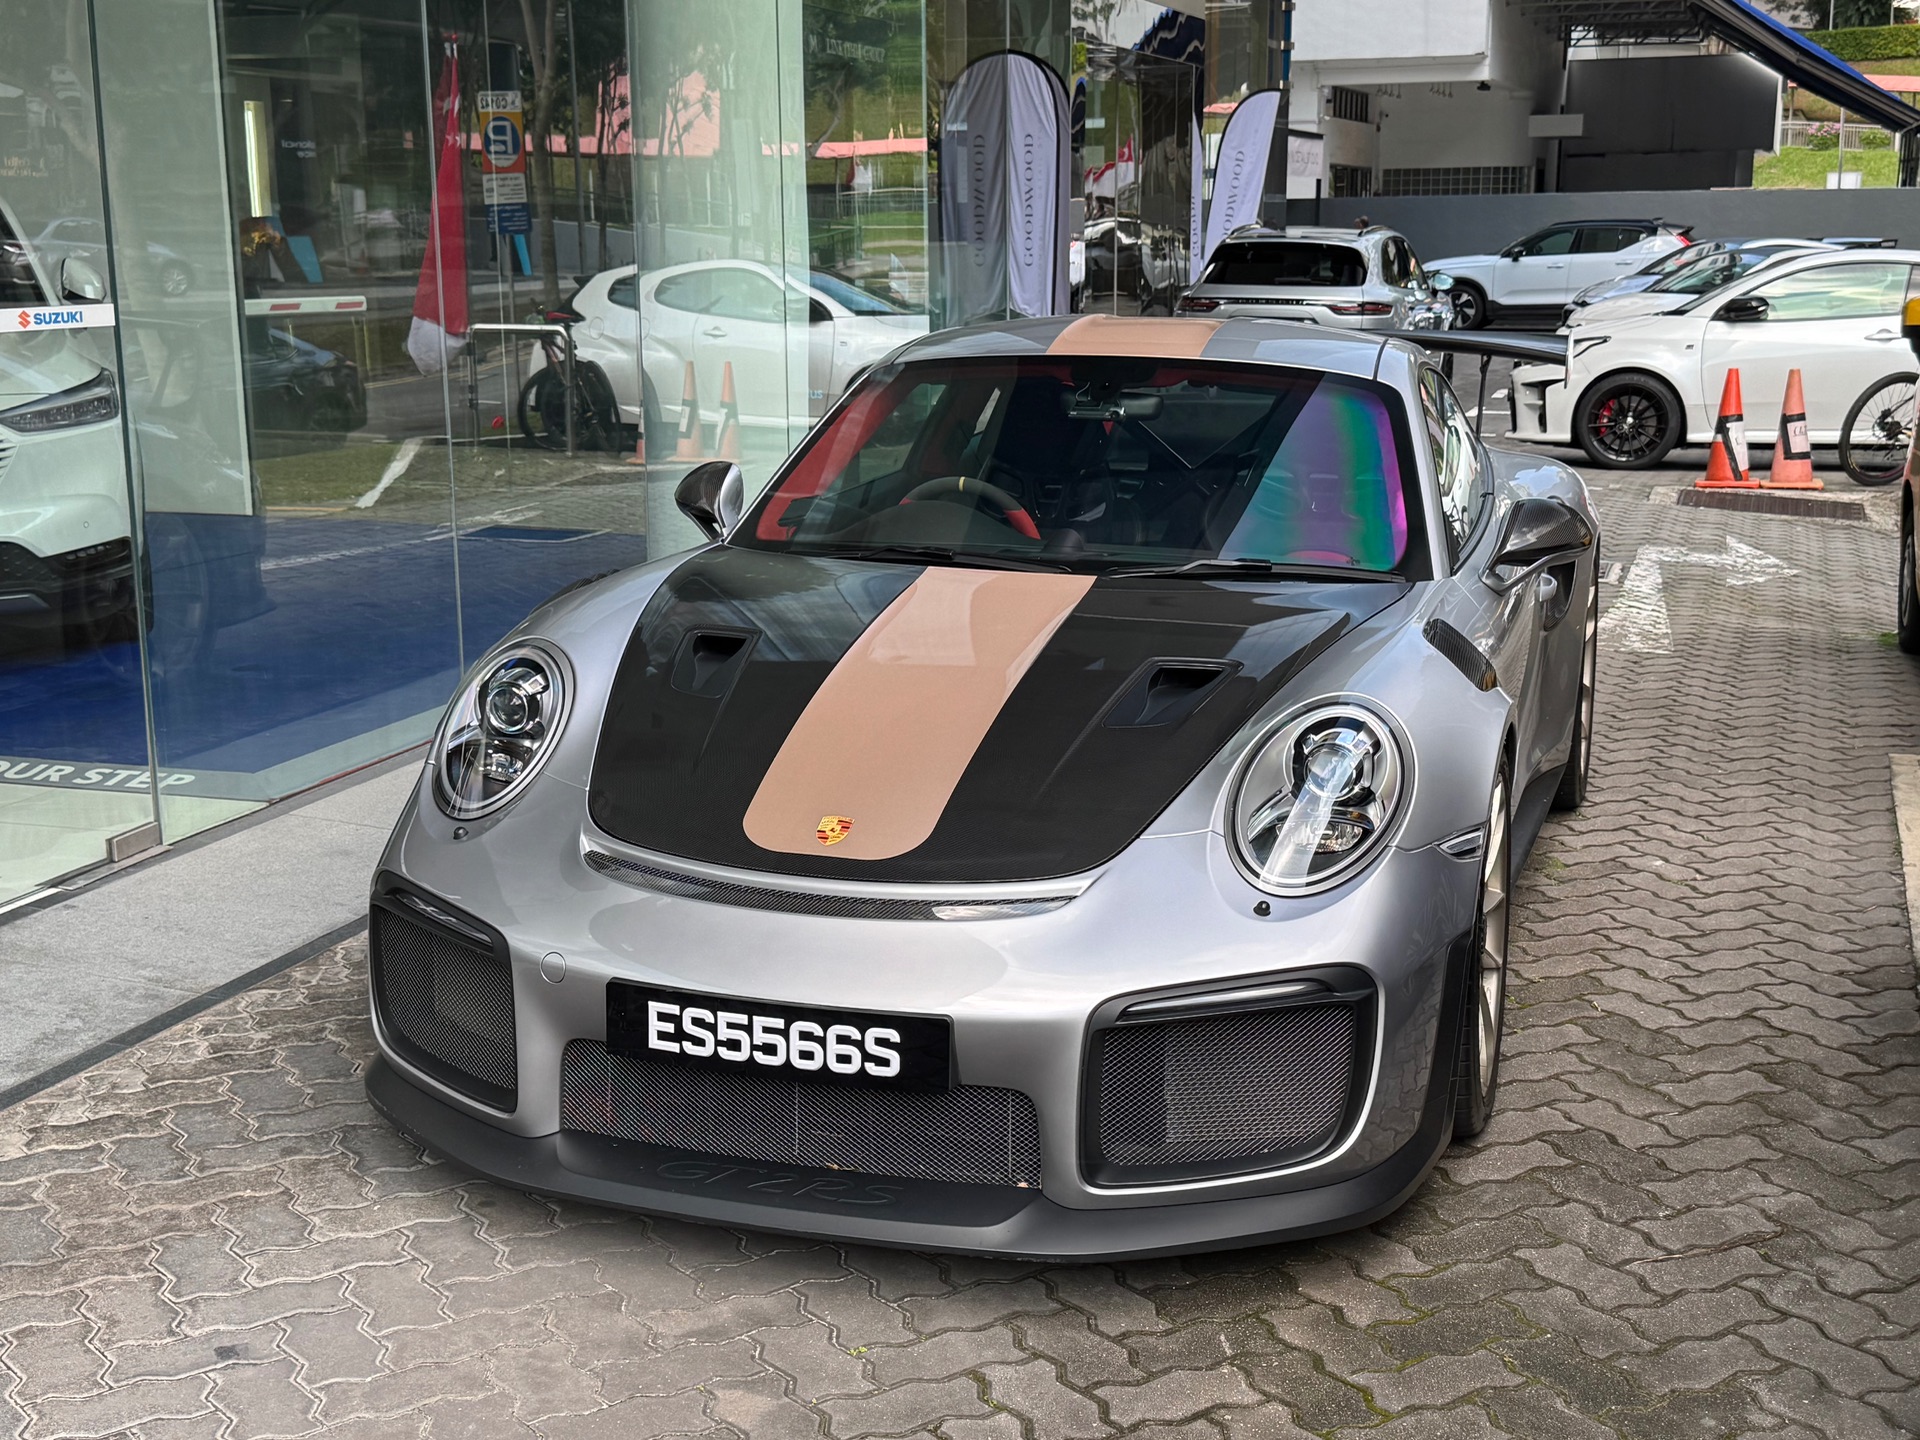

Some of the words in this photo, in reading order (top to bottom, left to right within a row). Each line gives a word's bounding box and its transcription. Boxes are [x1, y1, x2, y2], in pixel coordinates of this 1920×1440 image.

[1023, 133, 1035, 267] GOODWOOD
[1222, 150, 1245, 238] ODWOOD
[33, 311, 83, 325] SUZUKI
[72, 768, 196, 790] STEP
[646, 999, 902, 1078] ES5566S
